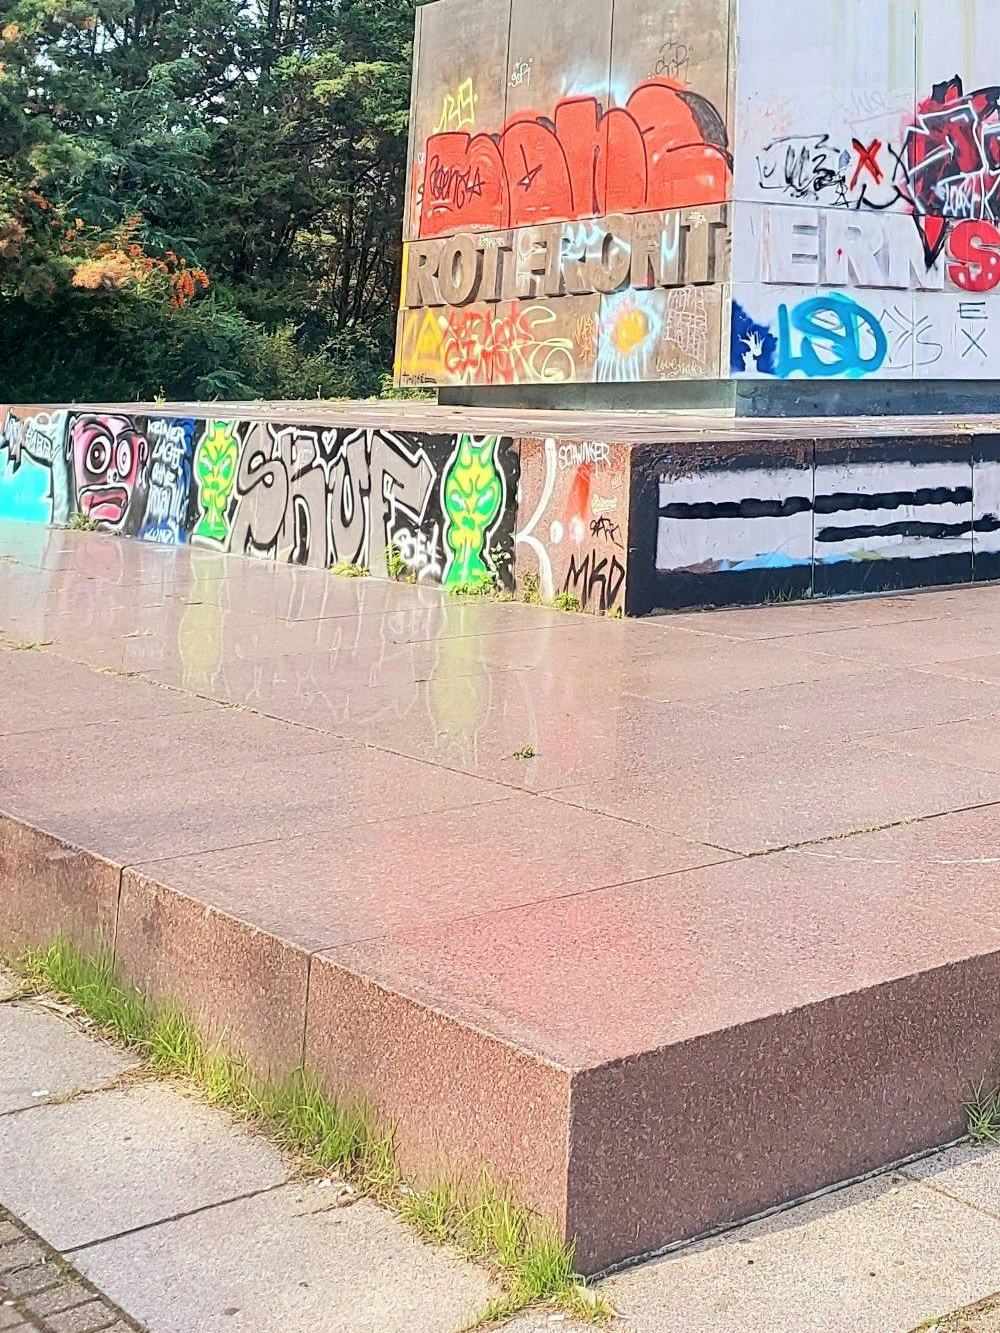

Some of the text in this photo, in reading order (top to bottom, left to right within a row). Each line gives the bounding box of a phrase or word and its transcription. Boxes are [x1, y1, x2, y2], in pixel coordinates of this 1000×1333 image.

[404, 233, 512, 308] ROT
[515, 204, 728, 299] FRONT
[562, 548, 627, 613] MKD
